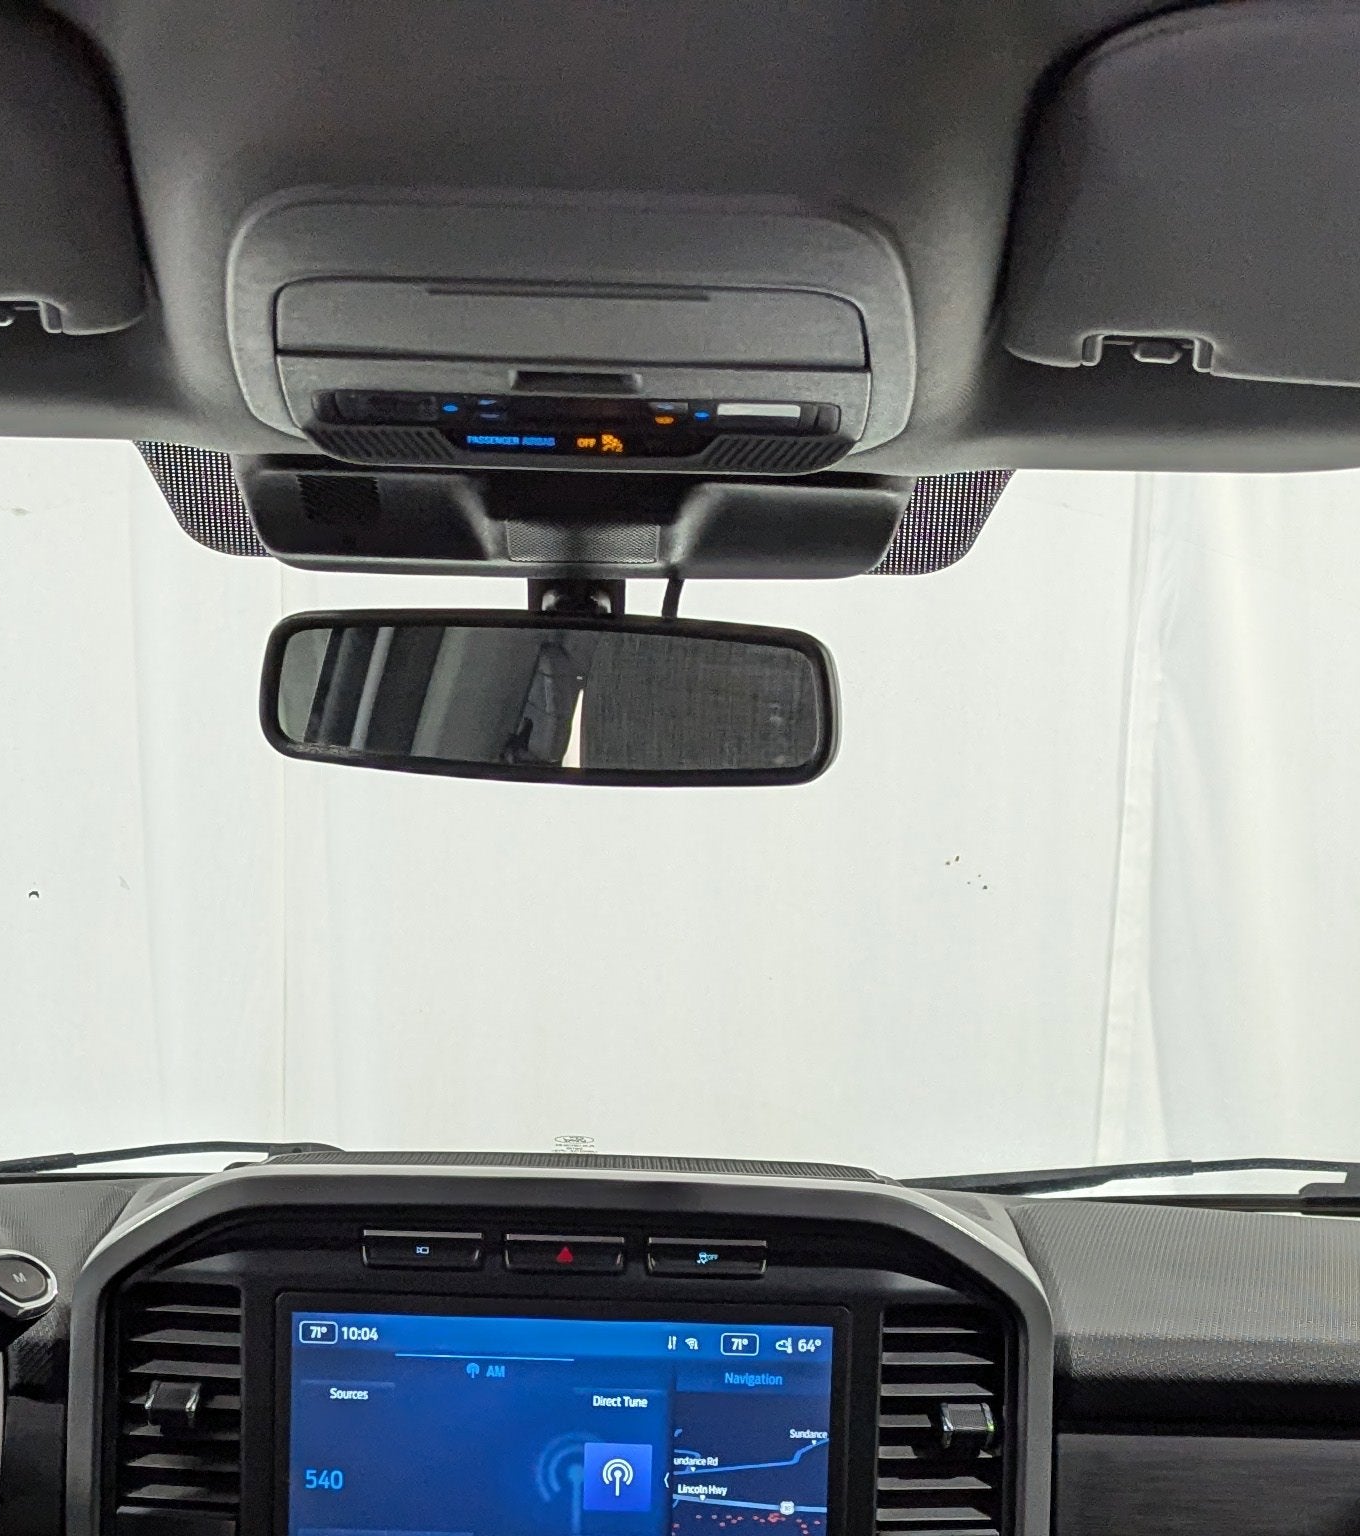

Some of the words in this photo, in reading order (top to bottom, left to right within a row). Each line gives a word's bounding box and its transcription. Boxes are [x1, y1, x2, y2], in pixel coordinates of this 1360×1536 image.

[466, 435, 520, 445] PASSENGER
[576, 438, 597, 448] OFF
[12, 1273, 27, 1283] M
[341, 1327, 378, 1341] 10:04
[798, 1339, 822, 1352] 64°
[486, 1365, 505, 1378] AM
[724, 1372, 783, 1387] Navigation
[329, 1388, 369, 1400] Sources
[593, 1396, 622, 1408] Direct
[623, 1396, 648, 1408] Tune
[790, 1429, 828, 1439] Sundance
[707, 1457, 719, 1466] Rd
[304, 1469, 344, 1489] 540
[677, 1483, 708, 1494] Lincoln
[709, 1485, 728, 1496] Hwy
